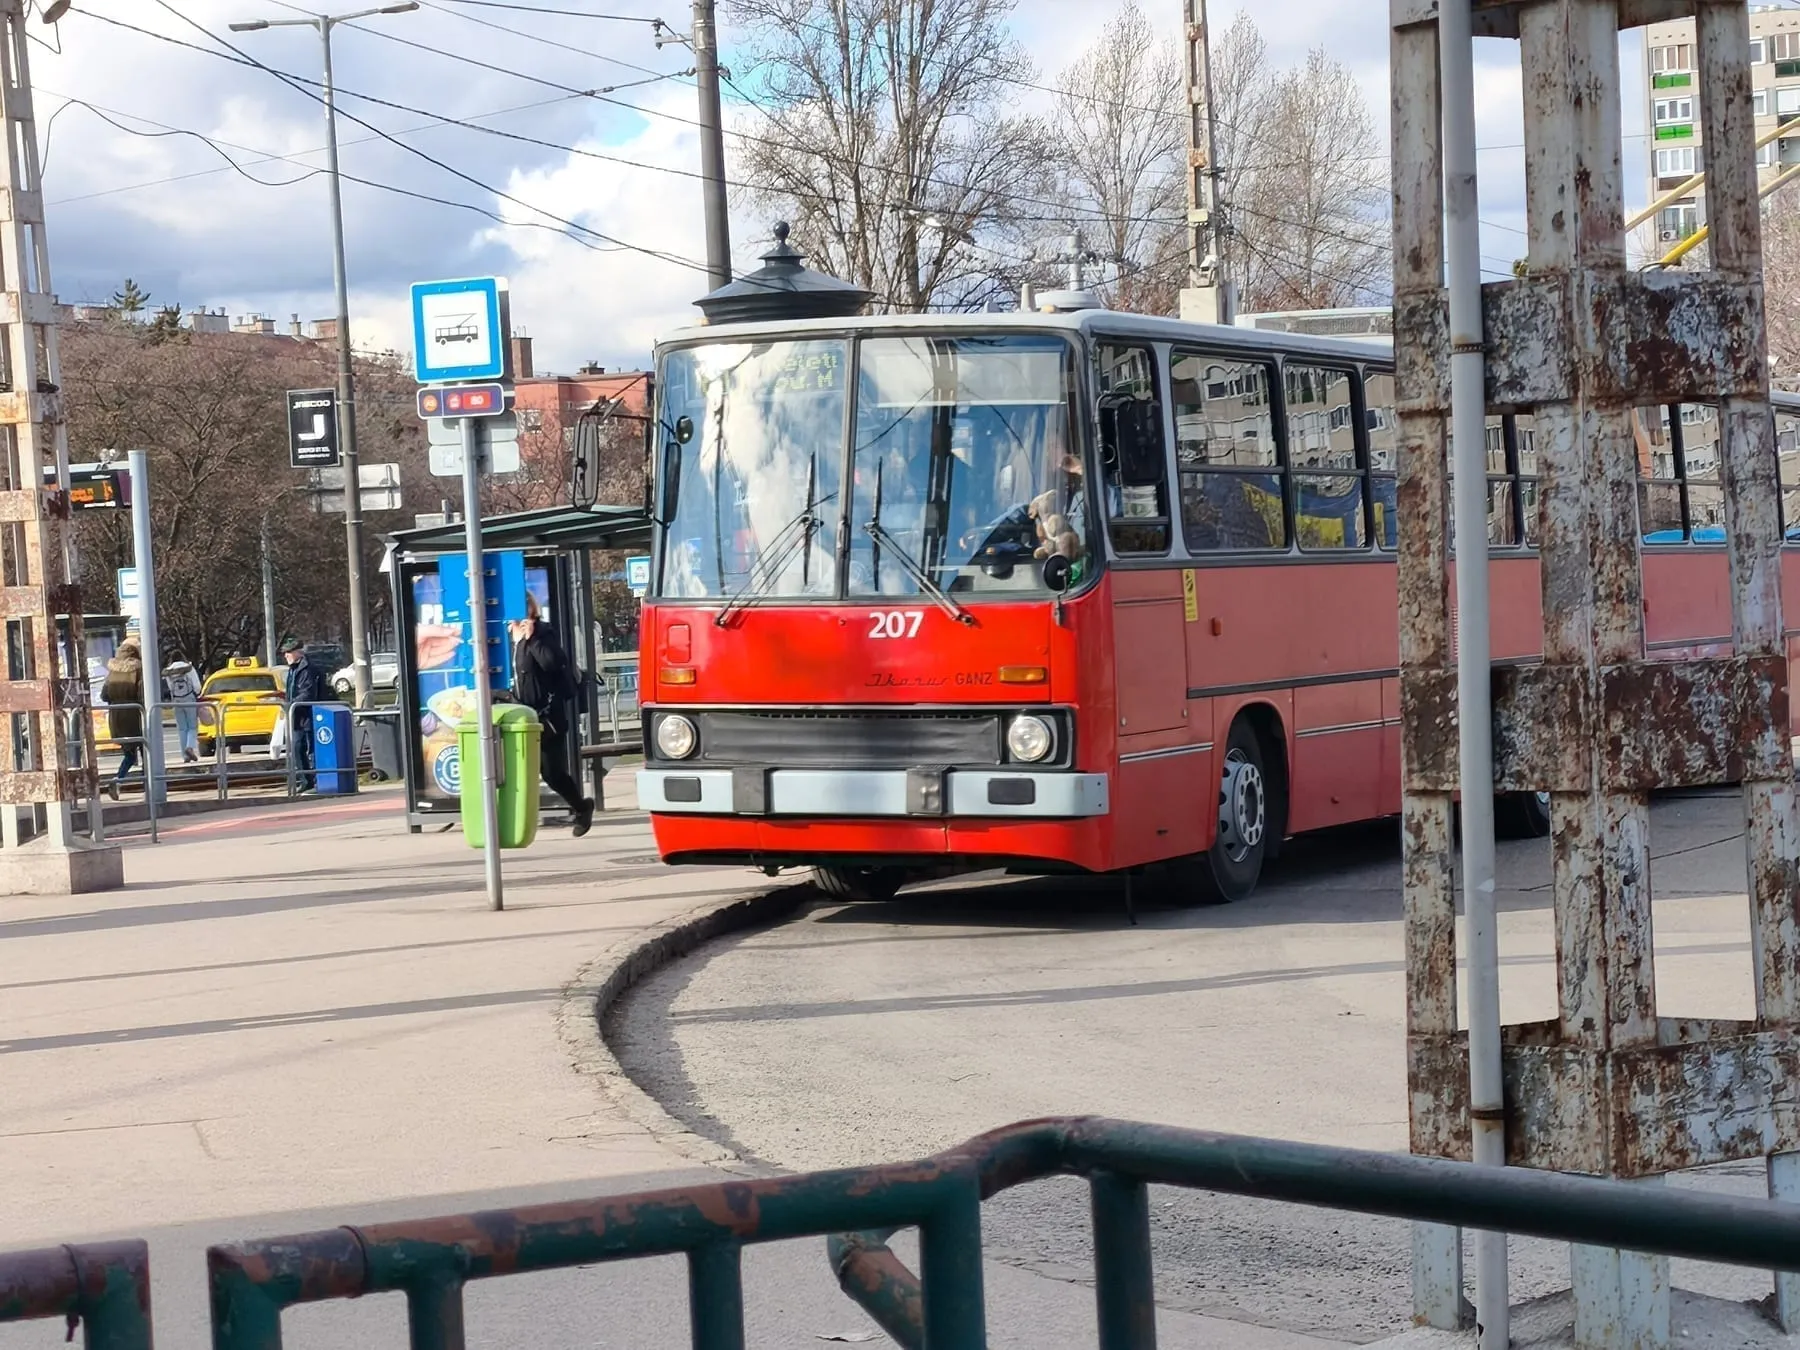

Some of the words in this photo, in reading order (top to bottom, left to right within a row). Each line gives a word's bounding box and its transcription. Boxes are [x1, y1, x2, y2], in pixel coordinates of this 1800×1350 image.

[868, 611, 924, 639] 207
[864, 673, 950, 687] Ikarus
[955, 672, 993, 685] GANZ
